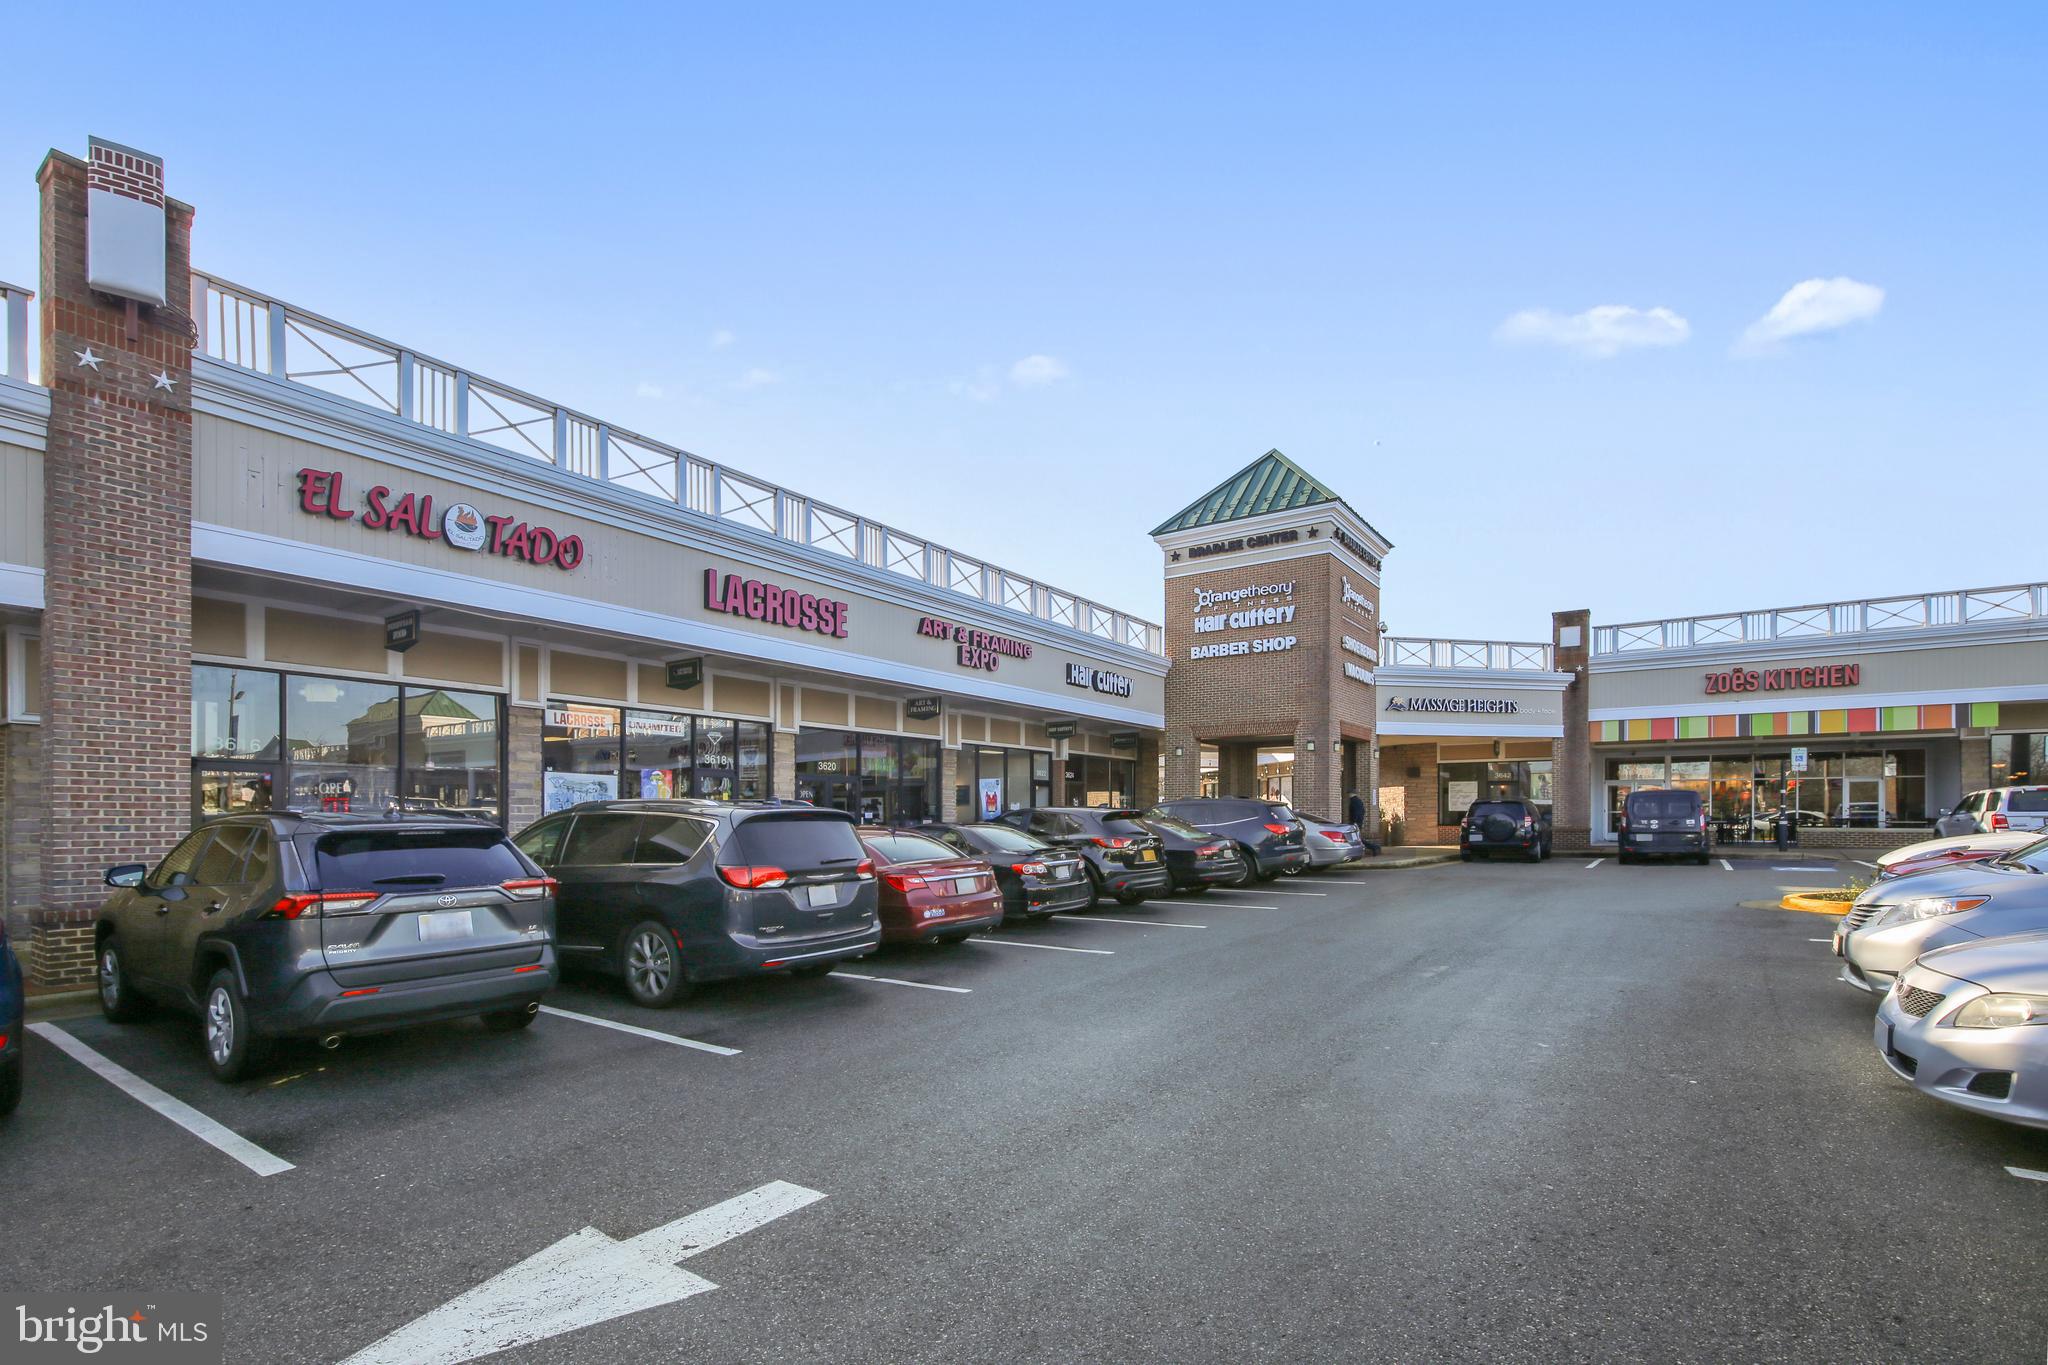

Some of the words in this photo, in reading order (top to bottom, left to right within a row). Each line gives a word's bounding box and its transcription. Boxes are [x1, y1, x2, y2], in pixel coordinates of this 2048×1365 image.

[297, 467, 354, 520] EL
[1247, 530, 1298, 548] CENTER
[704, 568, 849, 639] LACROSSE
[1213, 595, 1293, 612] FITNESS
[1194, 613, 1228, 634] Hair
[918, 617, 954, 640] ART
[955, 626, 969, 644] &
[969, 629, 1033, 660] FRAMING
[1190, 641, 1250, 660] BARBER
[1252, 635, 1297, 653] SHOP
[957, 645, 1001, 672] EXPO
[1066, 663, 1093, 688] Hair
[1763, 664, 1860, 691] KITCHEN
[1408, 697, 1465, 713] MASSAGE
[1466, 698, 1519, 714] HEIGHTS
[553, 711, 606, 728] LACROSSE
[704, 754, 728, 765] 3618
[817, 761, 837, 771] 3620
